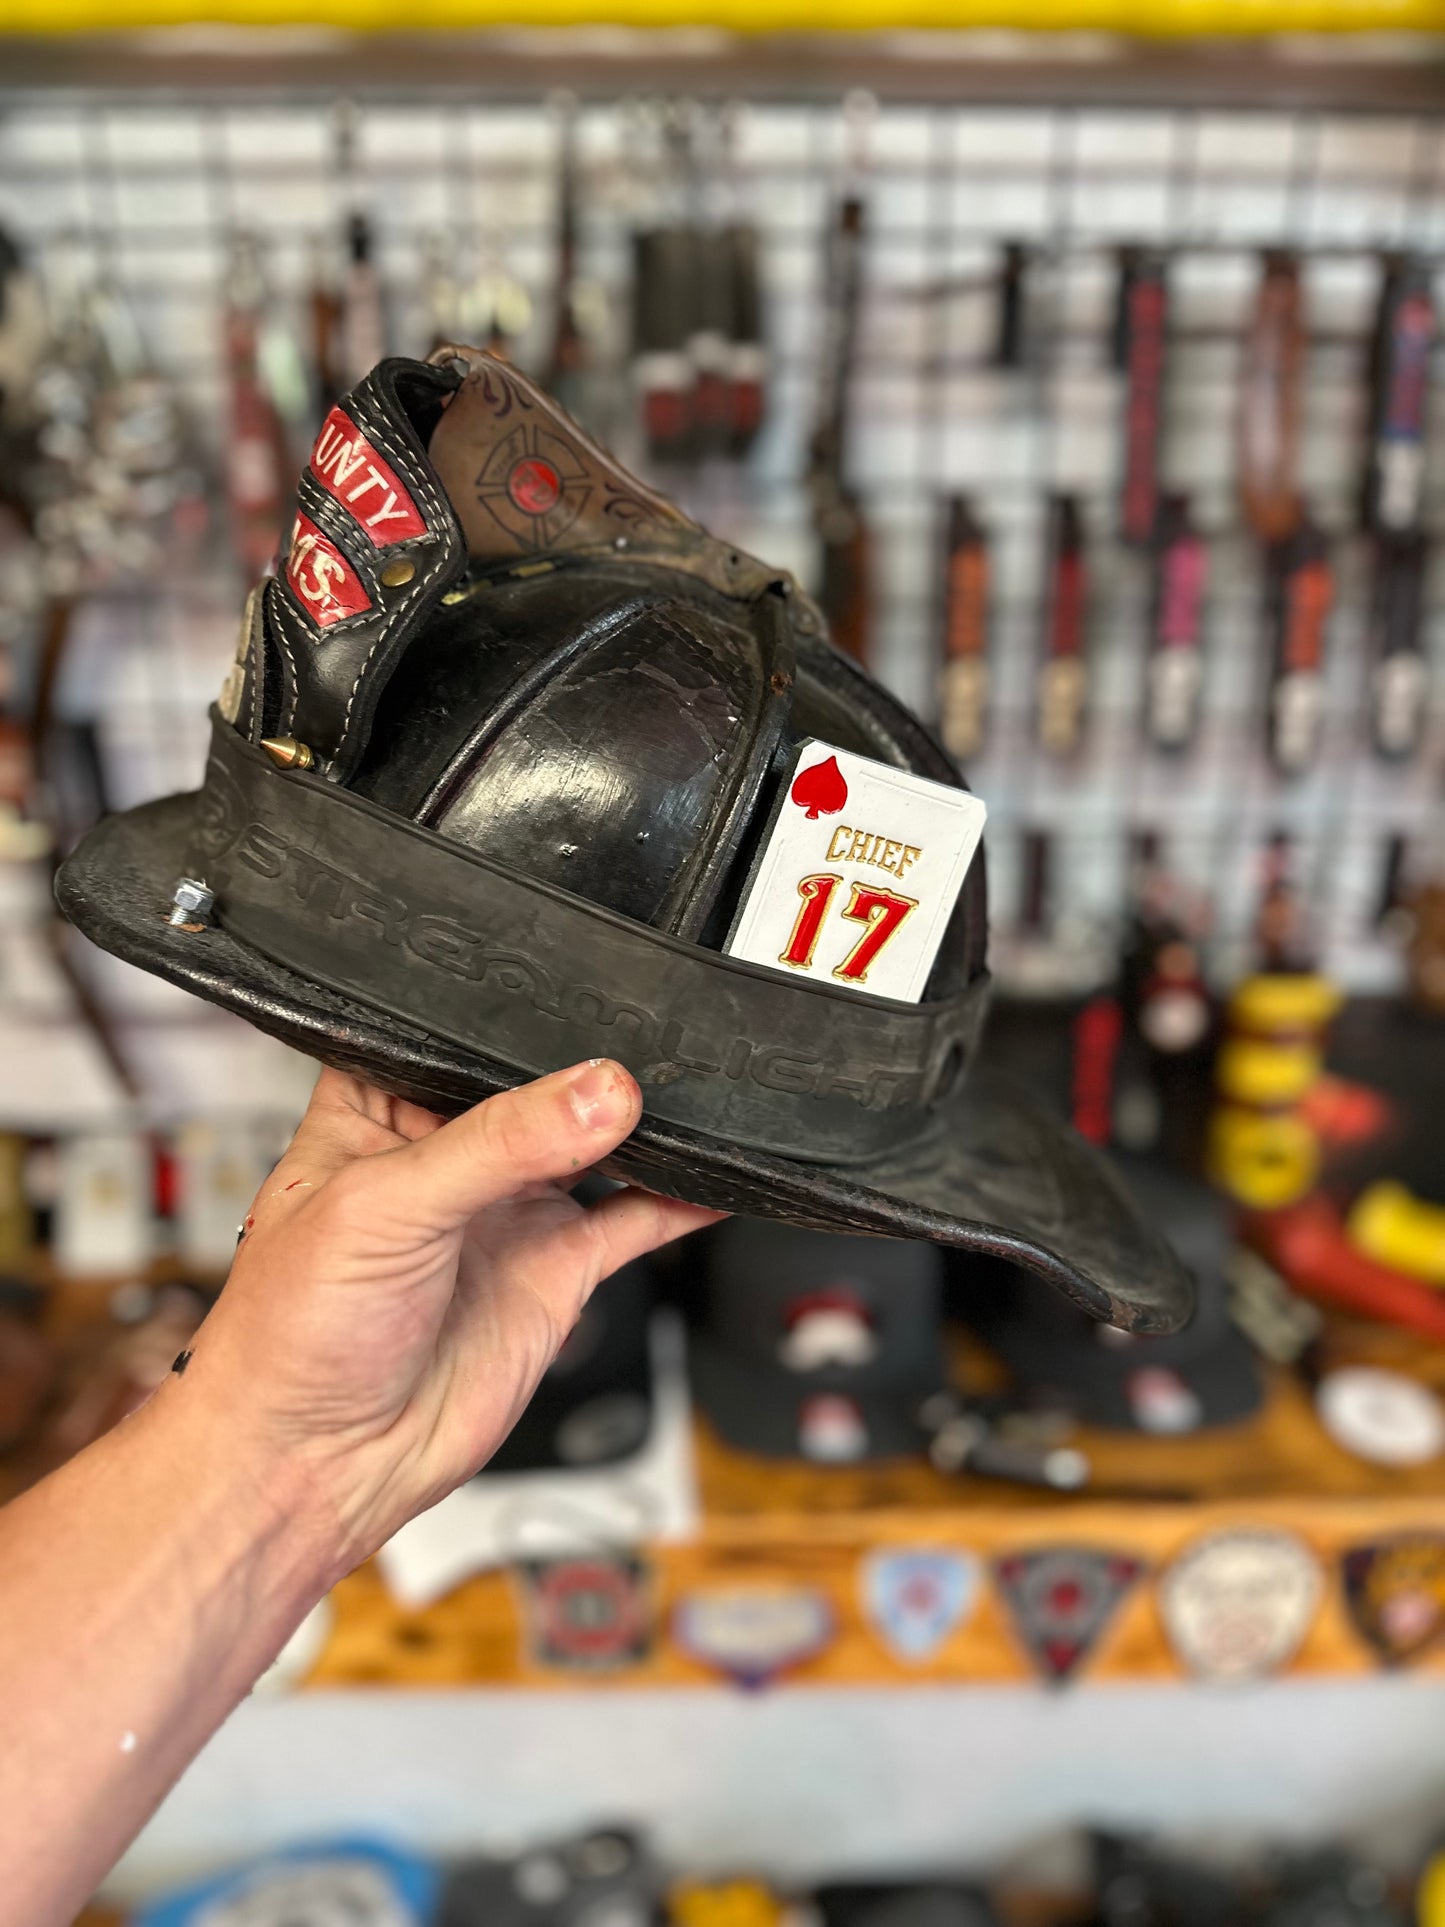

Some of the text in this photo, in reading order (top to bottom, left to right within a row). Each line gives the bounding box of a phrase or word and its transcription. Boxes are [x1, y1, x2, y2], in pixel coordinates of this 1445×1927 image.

[315, 423, 409, 529] UNTY
[825, 825, 923, 880] CHIEF
[239, 821, 925, 1108] STREAMLIGHT
[778, 873, 920, 984] 17
